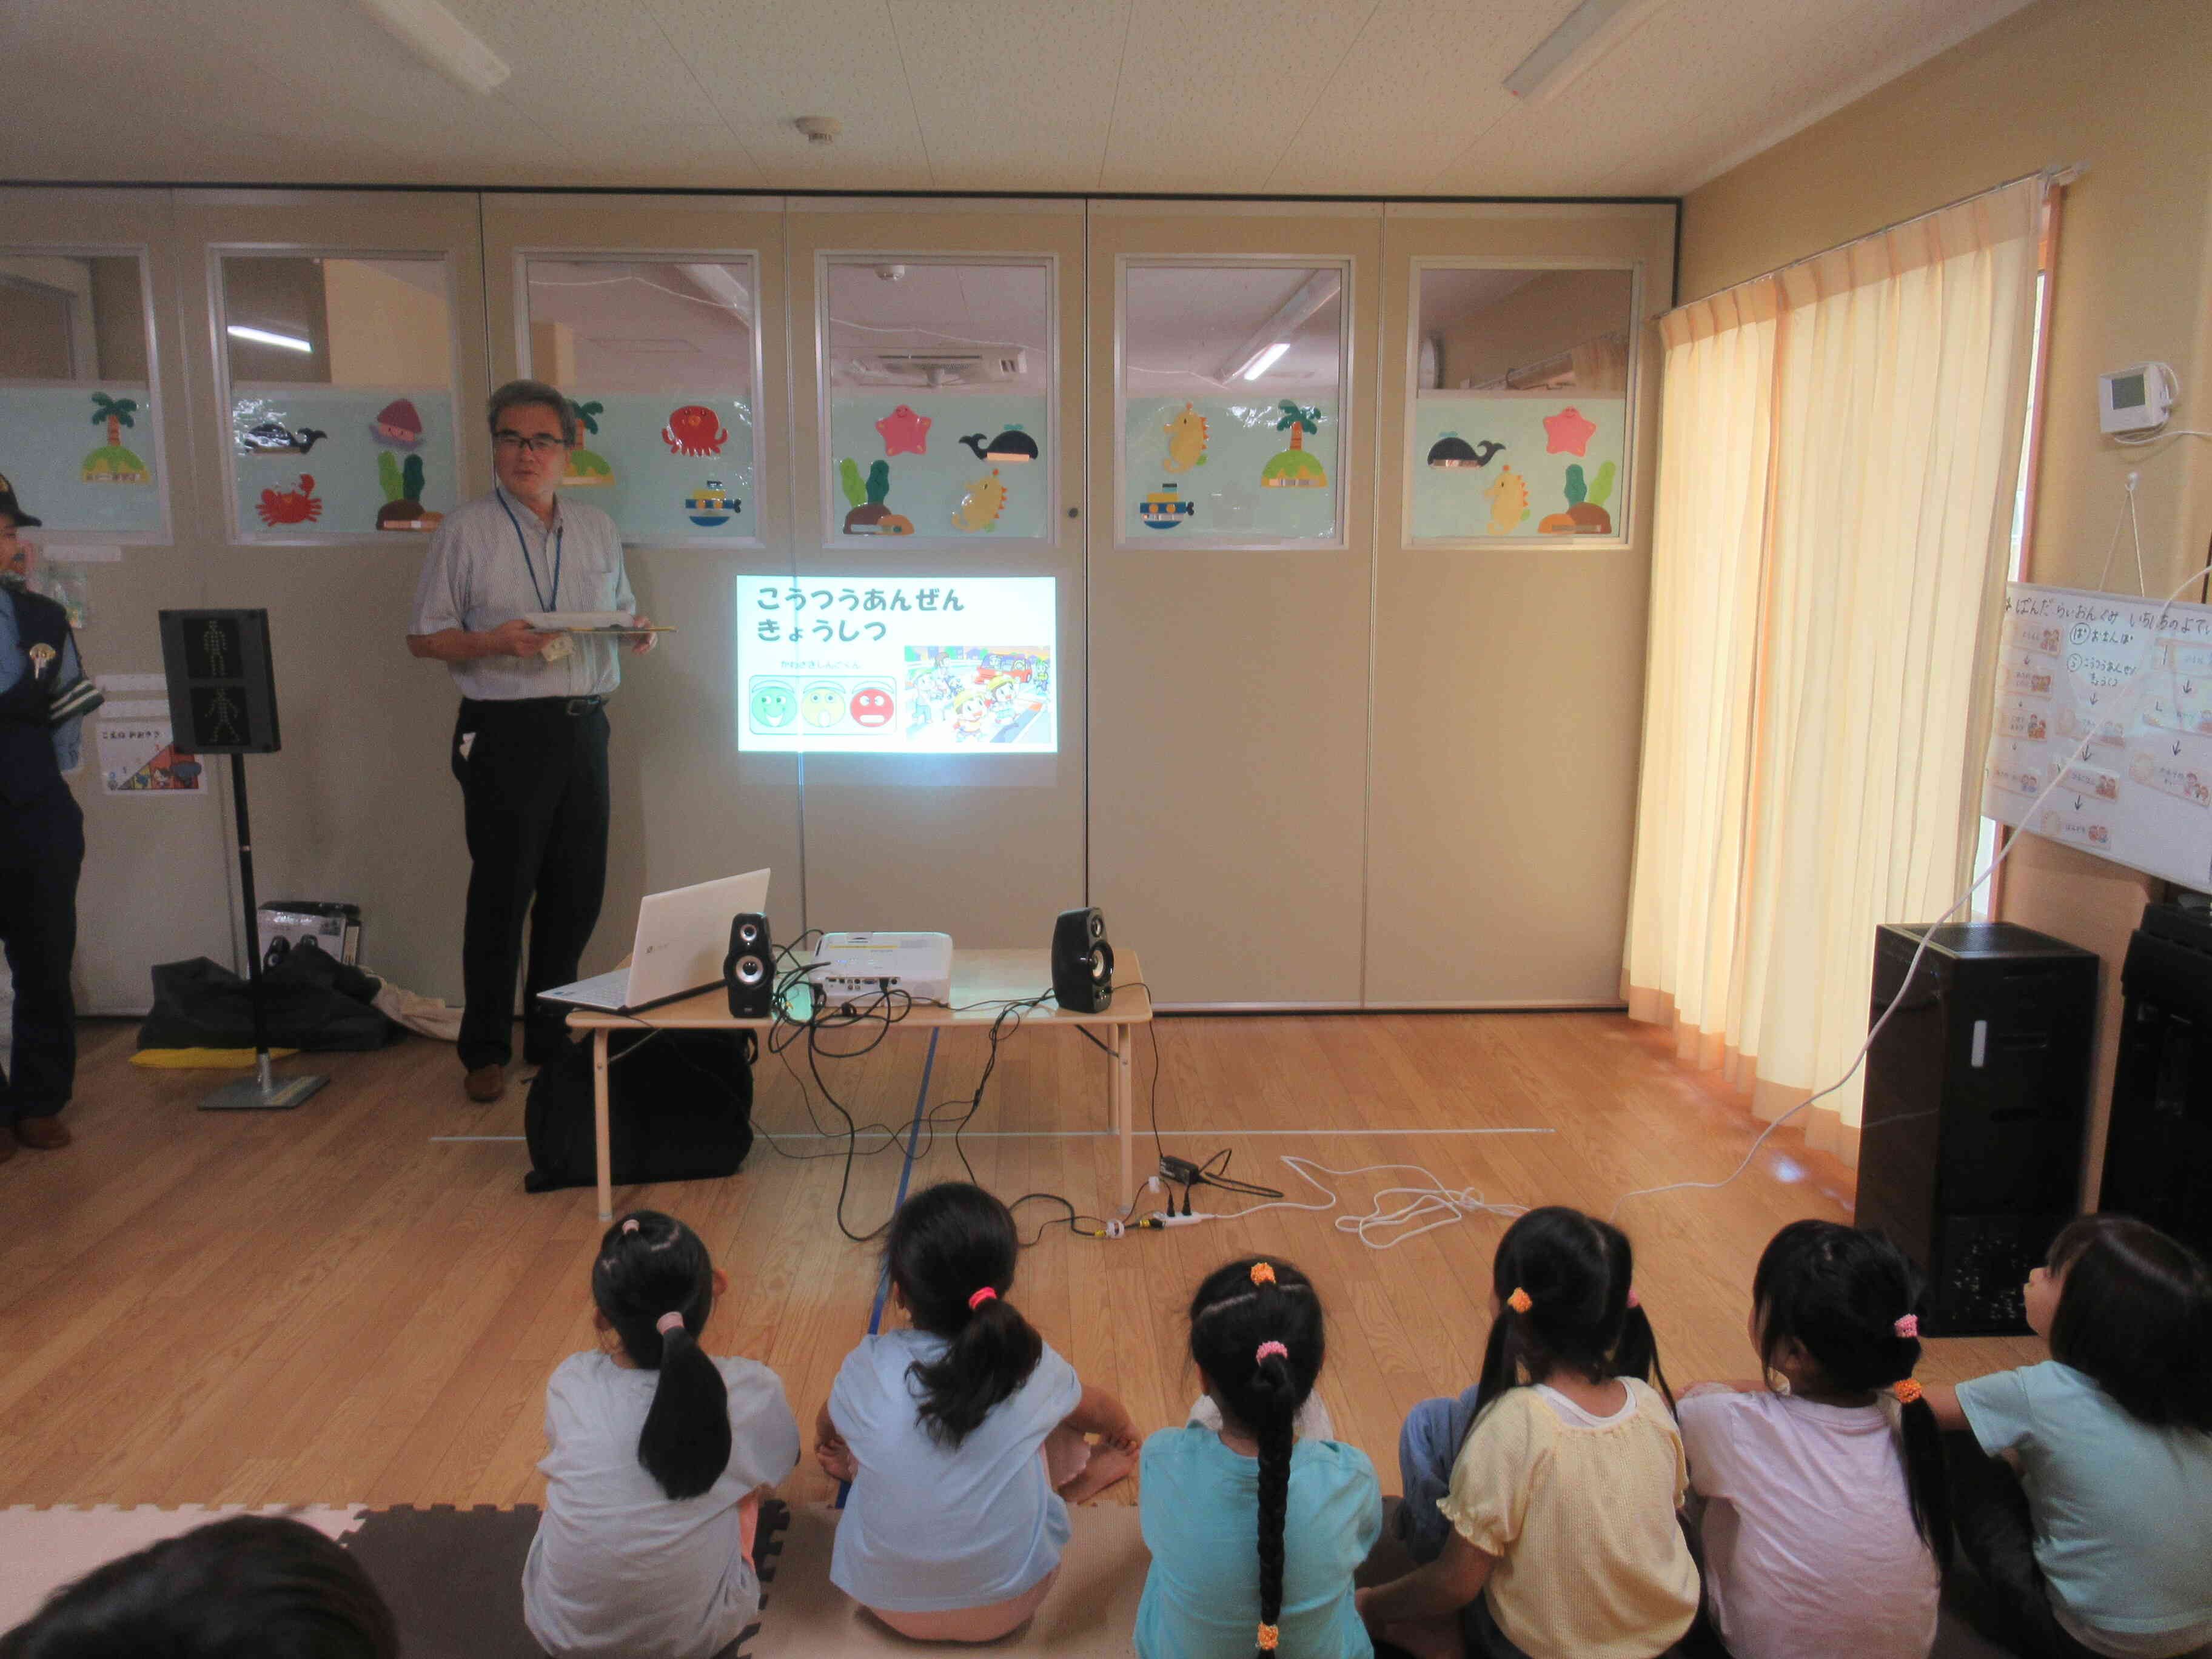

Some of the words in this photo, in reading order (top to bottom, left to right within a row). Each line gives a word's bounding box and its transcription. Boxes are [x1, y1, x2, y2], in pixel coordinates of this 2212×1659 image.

[757, 586, 965, 611] こうつうあんぜん
[757, 618, 886, 642] きょうしつ
